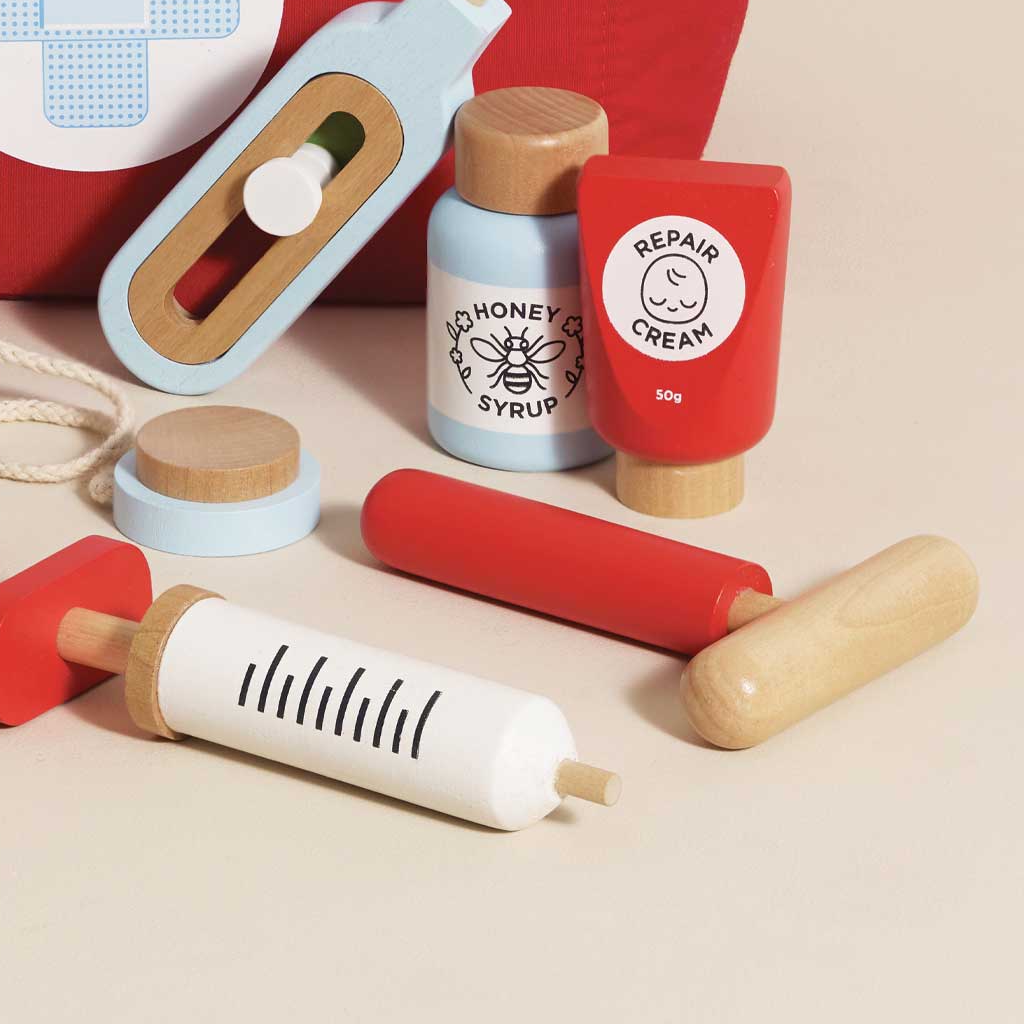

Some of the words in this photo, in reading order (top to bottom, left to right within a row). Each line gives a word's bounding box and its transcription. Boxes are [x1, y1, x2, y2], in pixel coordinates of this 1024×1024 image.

[633, 229, 720, 264] REPAIR
[473, 301, 561, 323] HONEY
[631, 317, 713, 350] CREAM
[478, 393, 558, 419] SYRUP
[655, 388, 682, 404] 50g
